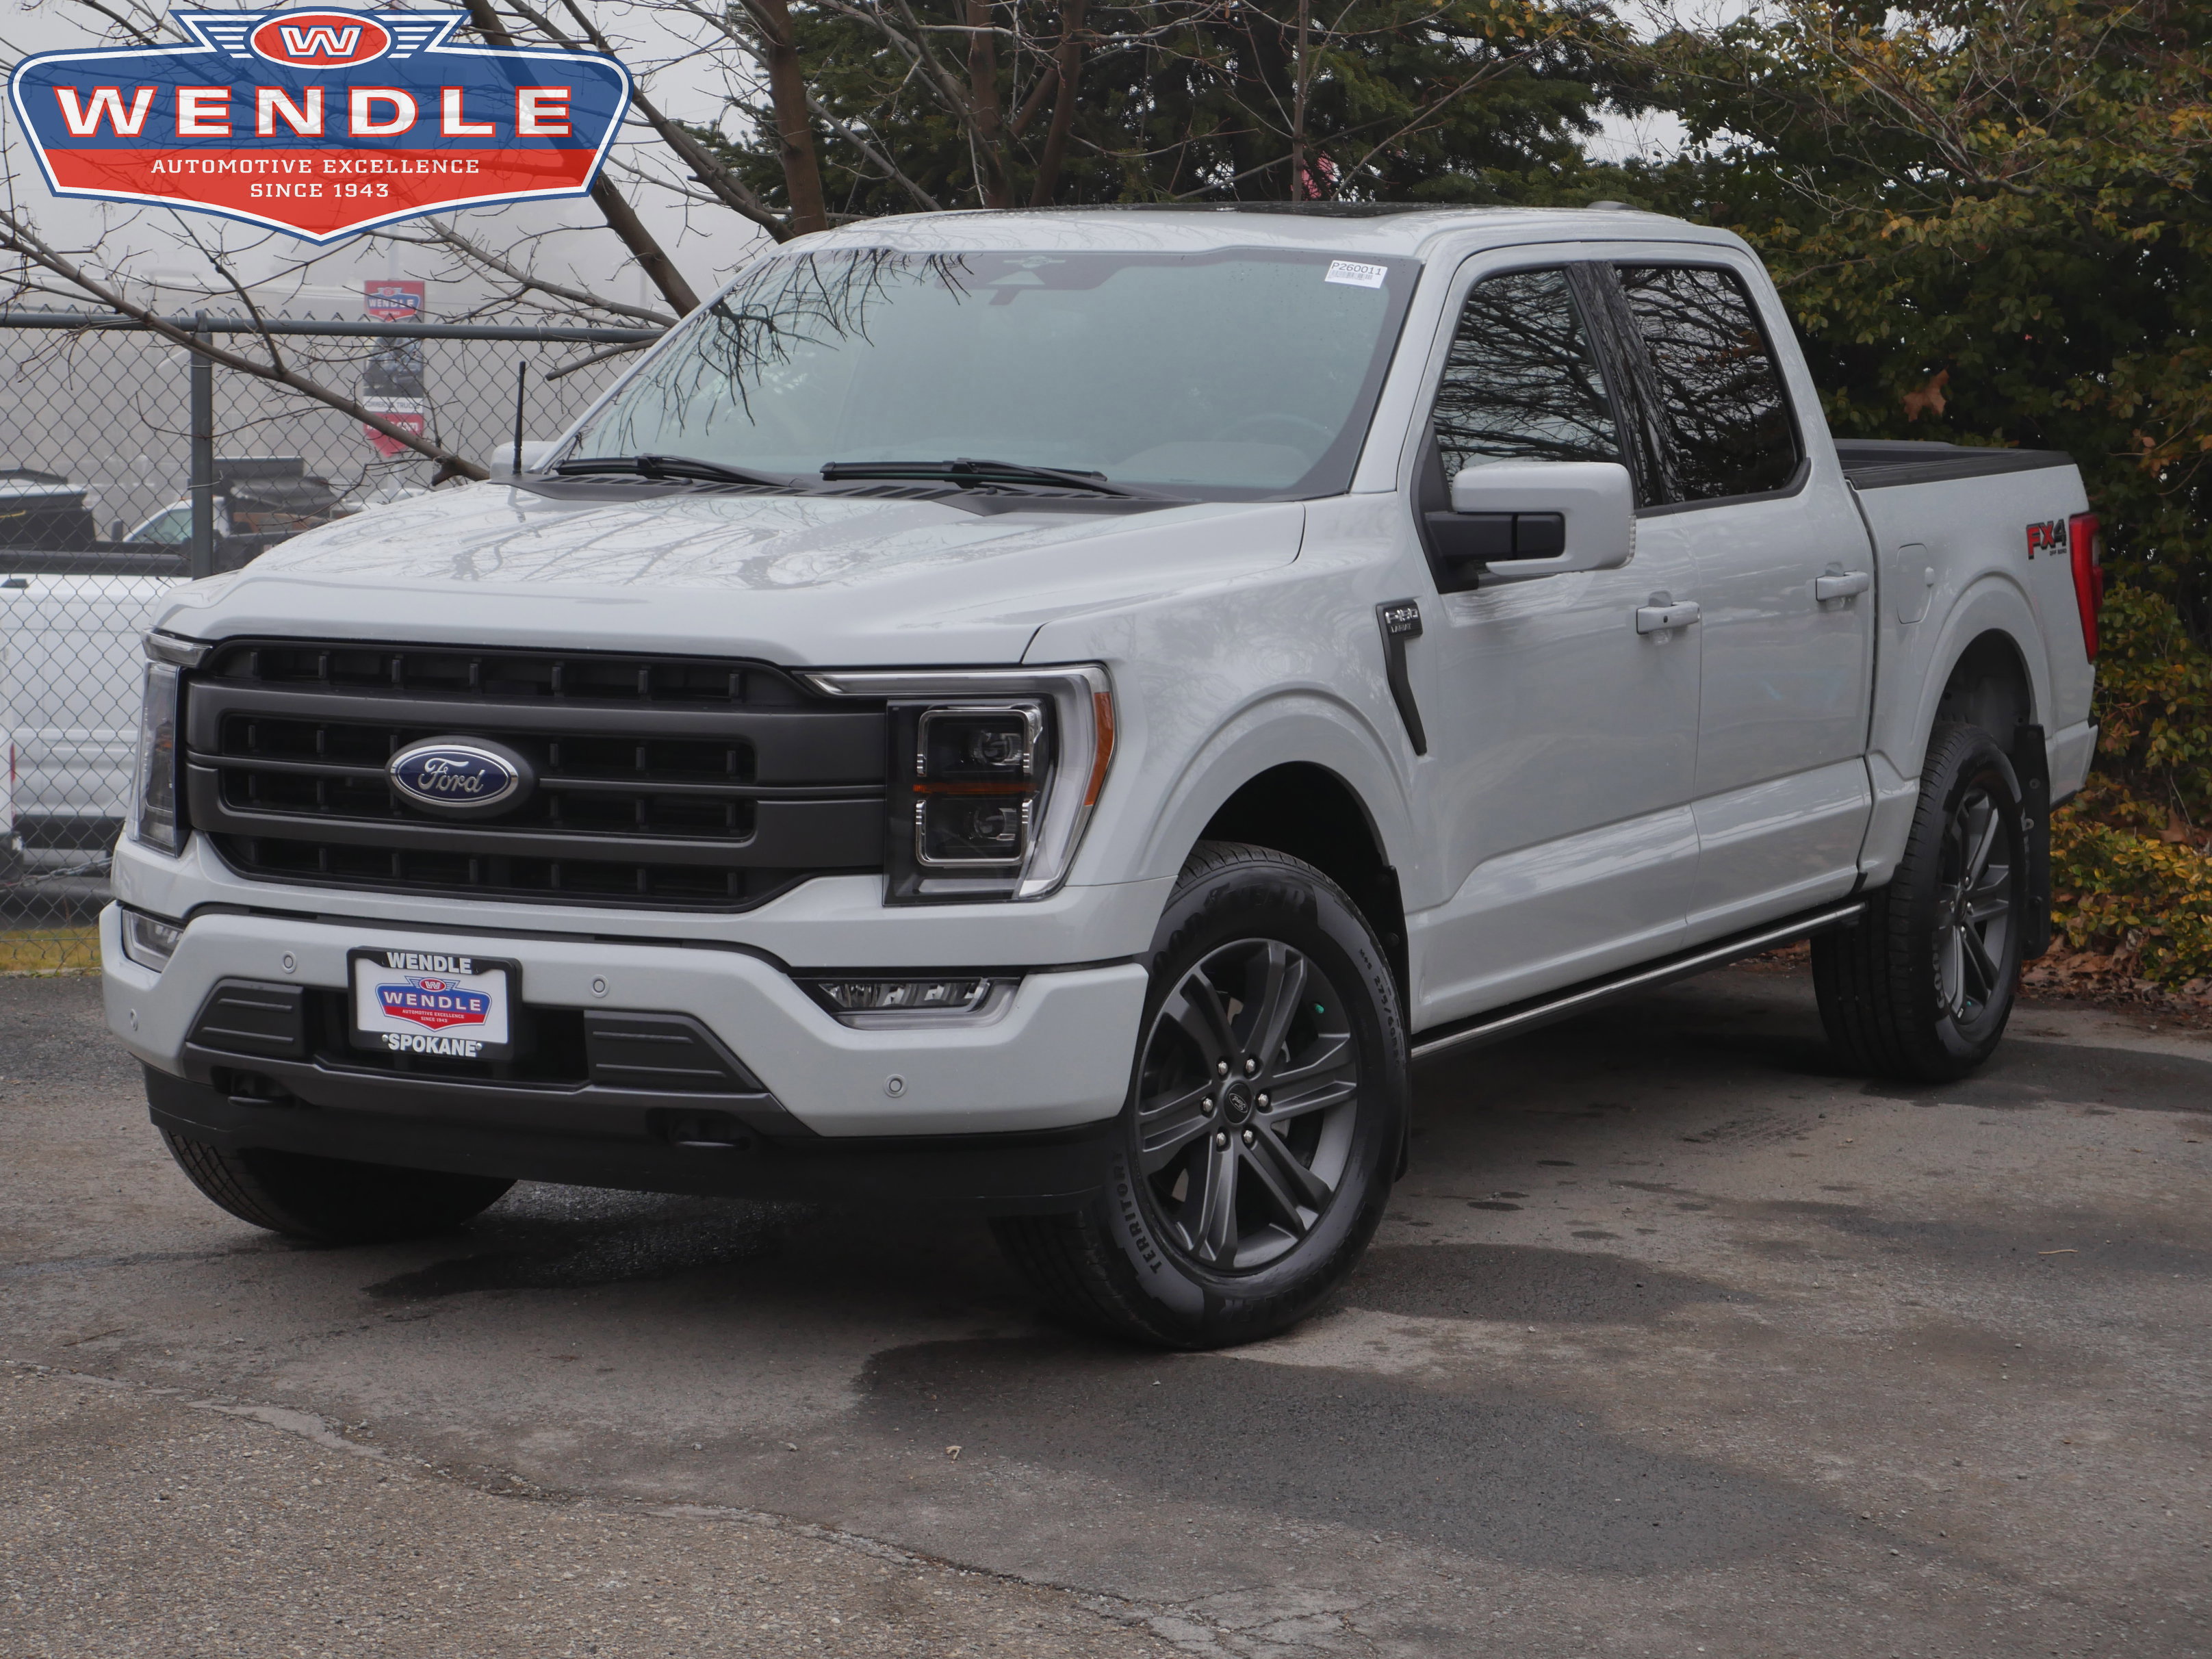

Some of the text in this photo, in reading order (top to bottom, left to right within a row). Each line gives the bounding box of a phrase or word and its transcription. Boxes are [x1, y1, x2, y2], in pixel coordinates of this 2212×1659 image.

[1332, 262, 1381, 275] P260011
[369, 298, 414, 307] WENDLE
[2027, 519, 2066, 560] FX4
[417, 758, 485, 793] Ford
[387, 952, 472, 975] WENDLE
[383, 992, 480, 1012] WENDLE
[388, 1033, 476, 1057] SPOKANE
